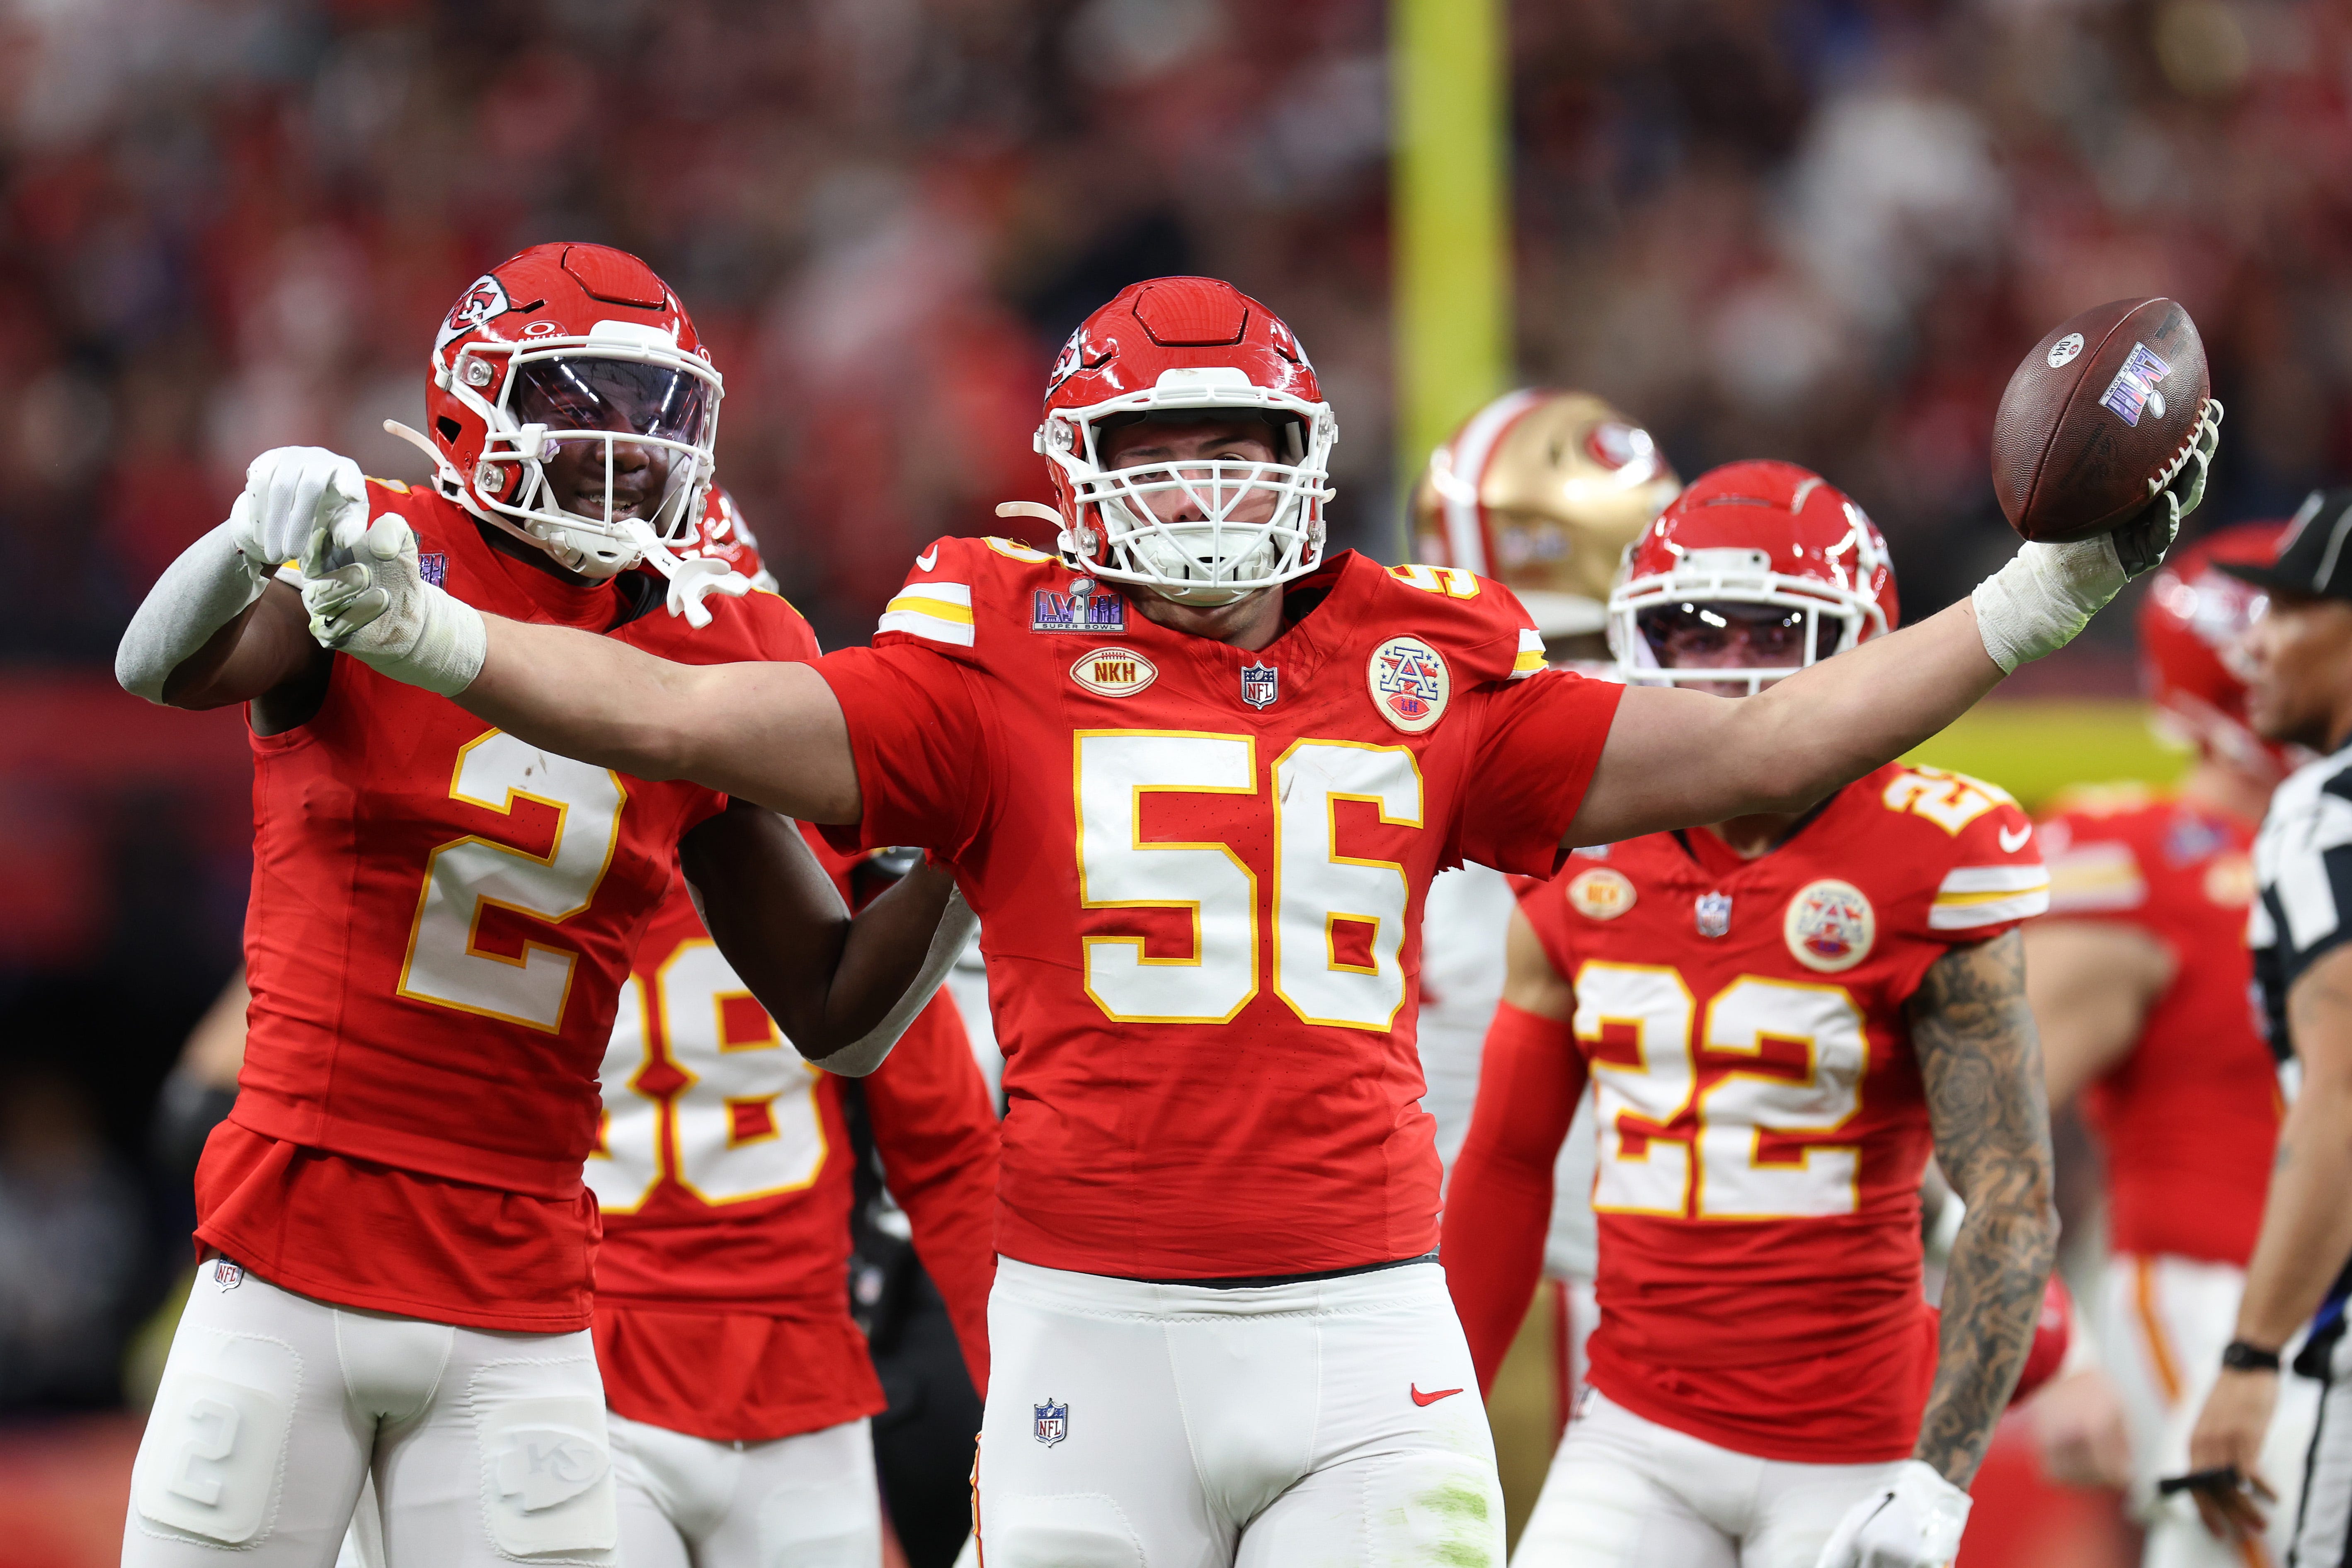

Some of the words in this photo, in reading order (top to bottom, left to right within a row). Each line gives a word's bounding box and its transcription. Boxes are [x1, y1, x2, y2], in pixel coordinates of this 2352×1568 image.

[2122, 348, 2139, 372] SUPER
[2104, 376, 2123, 398] BOWL
[1094, 661, 1136, 683] NKH
[1247, 683, 1272, 701] NFL
[1401, 698, 1418, 713] LH
[396, 727, 628, 1035] 2
[1073, 729, 1424, 1033] 56
[1573, 959, 1869, 1220] 22
[217, 1265, 236, 1283] NFL
[1039, 1420, 1061, 1438] NFL
[167, 1397, 240, 1507] 2
